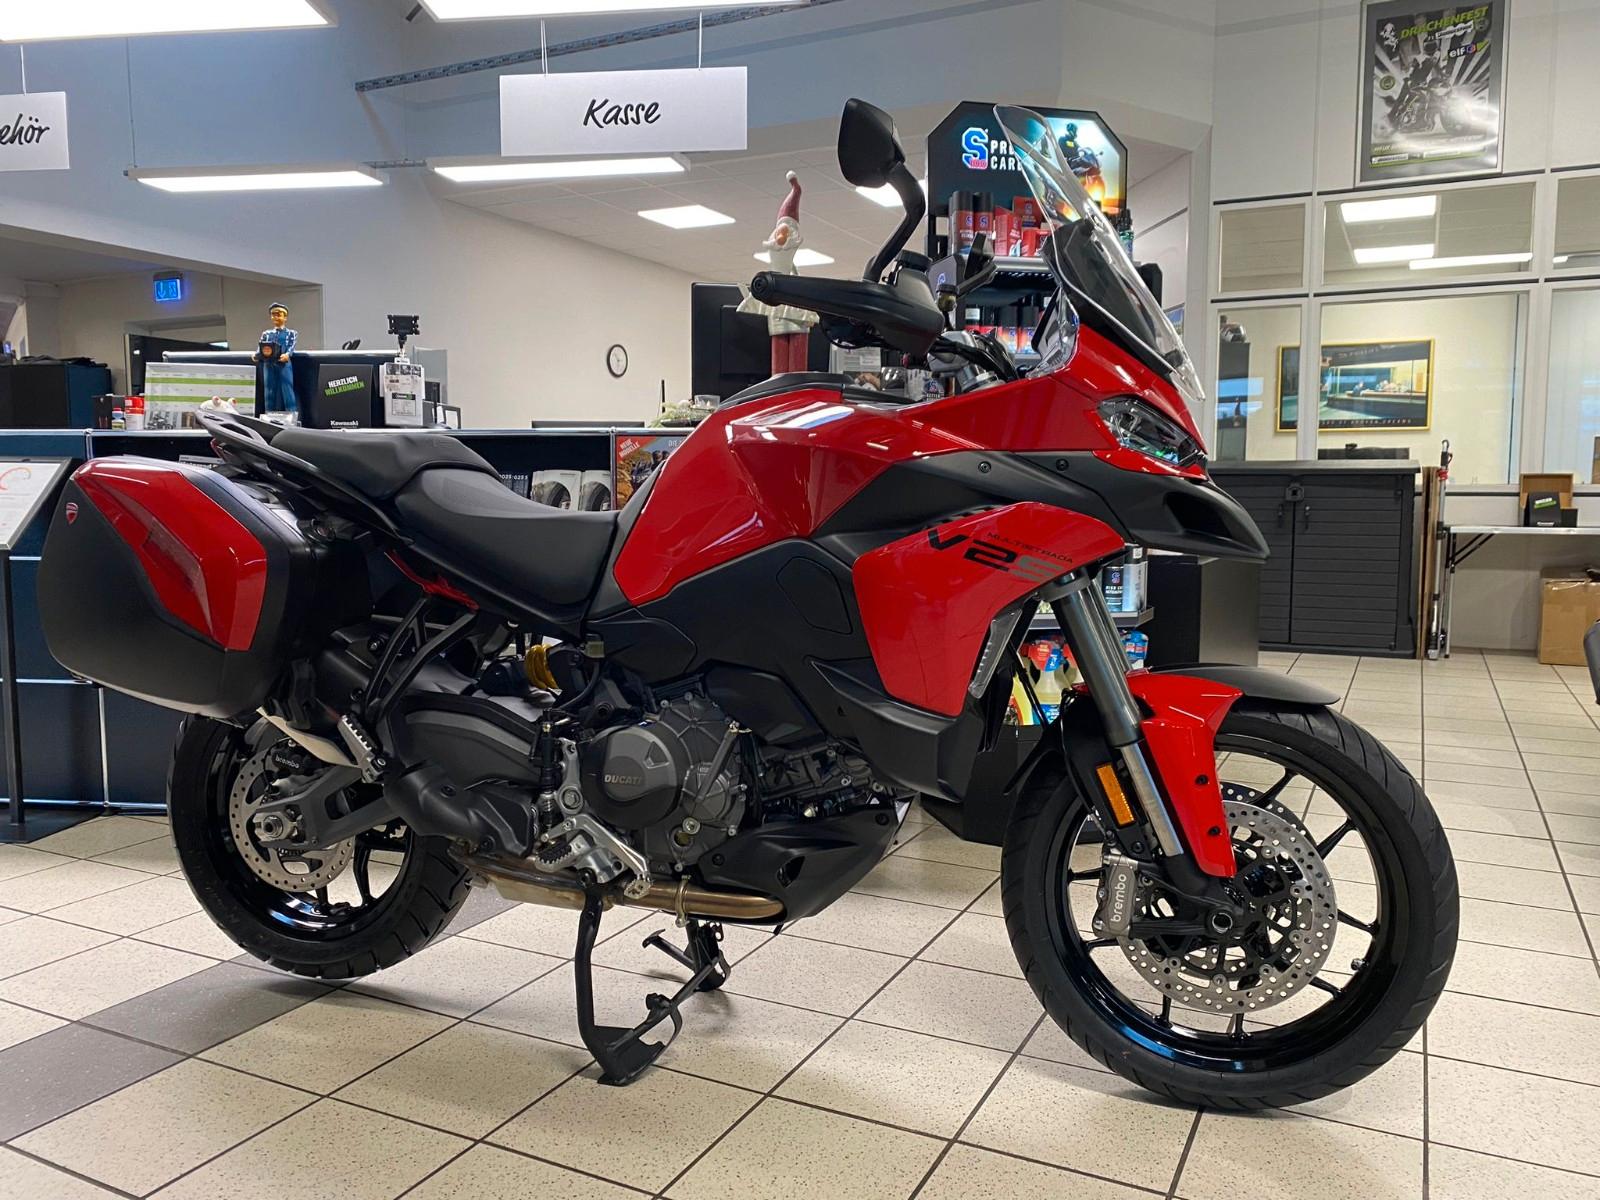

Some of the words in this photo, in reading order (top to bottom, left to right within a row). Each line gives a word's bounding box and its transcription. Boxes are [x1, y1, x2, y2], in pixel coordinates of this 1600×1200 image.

[1400, 6, 1489, 39] DRACHENFEST
[1449, 47, 1466, 58] elf
[582, 98, 661, 128] Kasse
[328, 375, 358, 388] HERZLICH
[986, 531, 1073, 564] MULTISTRADA
[275, 754, 300, 769] brembo
[604, 774, 641, 785] DUCATI
[1110, 873, 1127, 922] brembo
